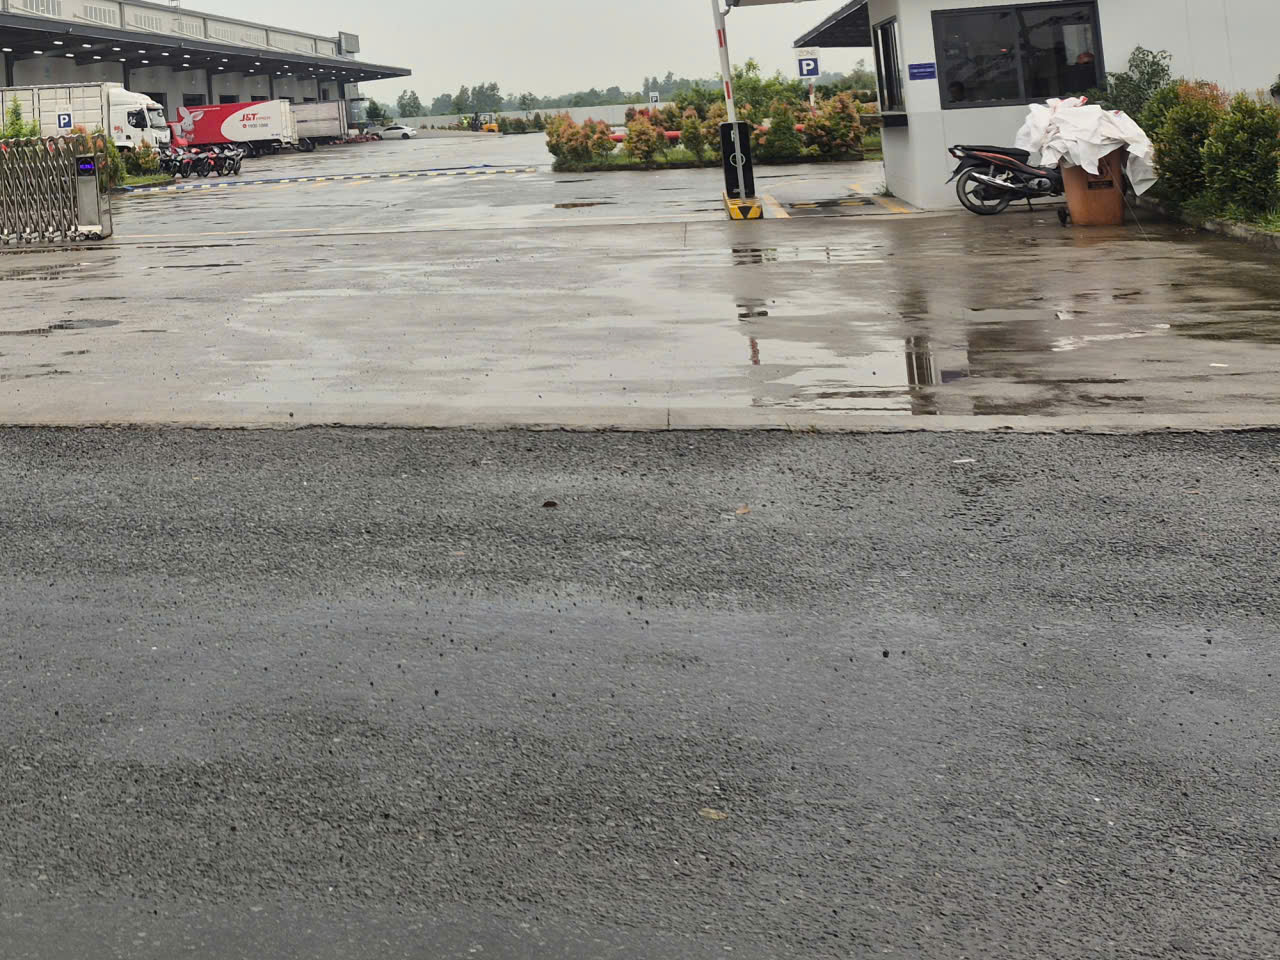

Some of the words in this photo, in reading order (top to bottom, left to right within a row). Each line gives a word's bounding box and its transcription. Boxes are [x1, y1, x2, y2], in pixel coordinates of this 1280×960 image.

[802, 60, 814, 75] P
[60, 115, 69, 127] P
[240, 113, 258, 121] J&T
